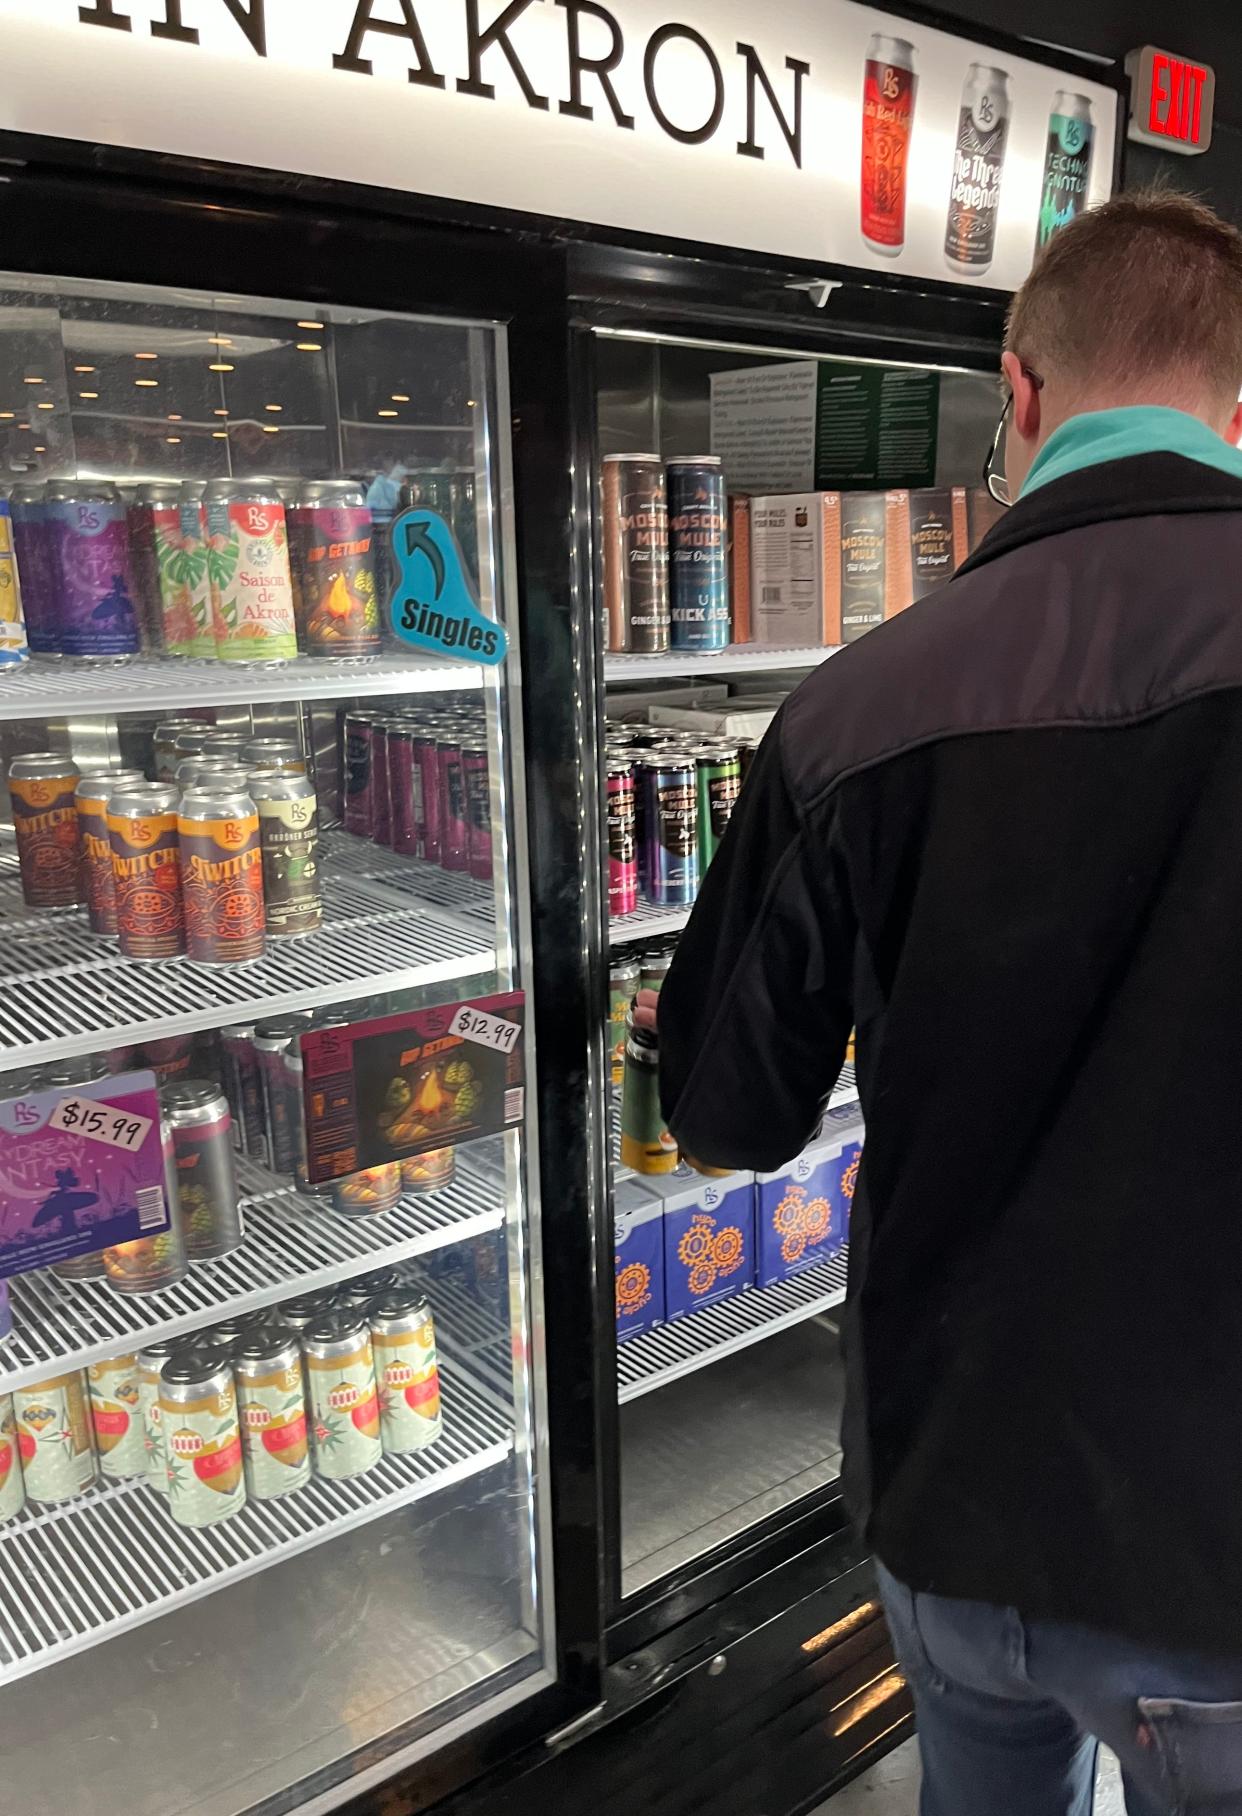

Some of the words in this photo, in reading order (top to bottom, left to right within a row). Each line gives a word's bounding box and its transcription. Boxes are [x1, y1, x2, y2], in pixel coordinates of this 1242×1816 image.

[331, 0, 810, 169] AKRON
[1149, 53, 1207, 144] EXIT
[239, 571, 285, 586] Saison
[257, 587, 276, 604] de
[242, 605, 290, 620] Akron
[401, 598, 498, 656] Singles
[672, 608, 705, 622] KICK
[458, 1011, 515, 1047] $12.99
[62, 1101, 141, 1145] $15.99
